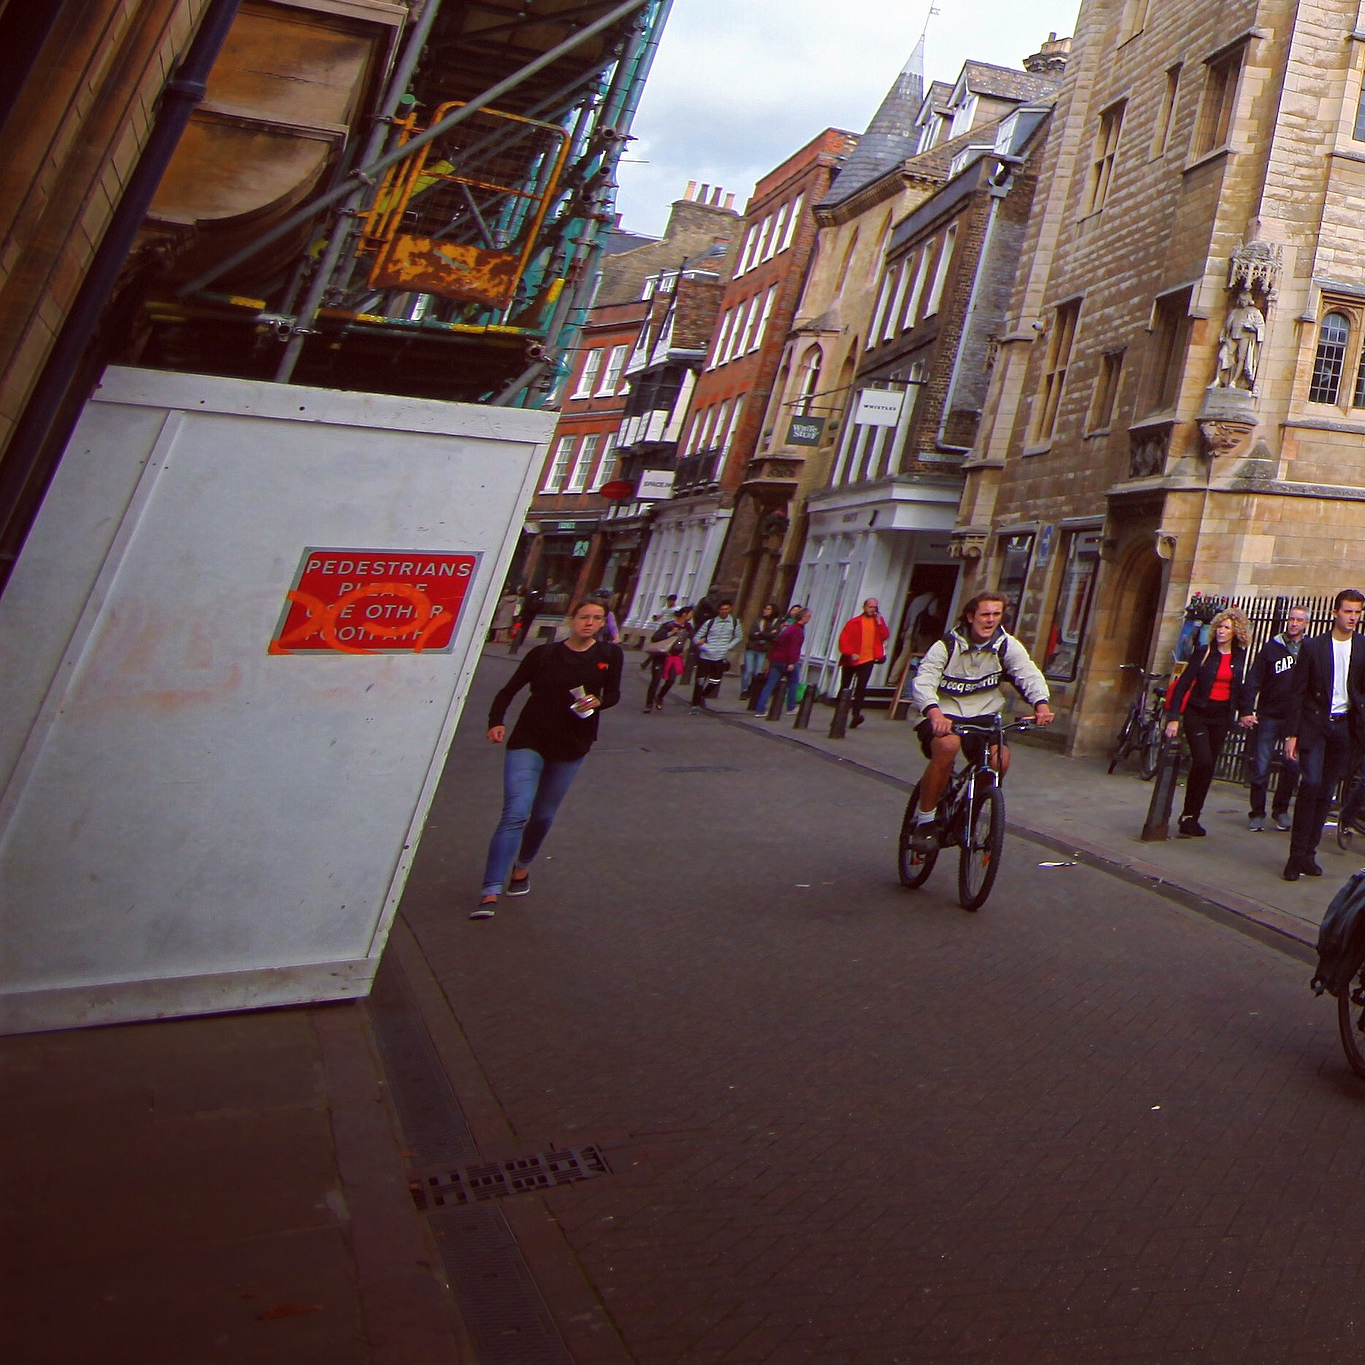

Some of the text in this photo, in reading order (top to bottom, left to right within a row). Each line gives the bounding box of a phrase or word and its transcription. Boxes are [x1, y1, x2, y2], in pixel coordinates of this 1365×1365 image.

[306, 560, 471, 577] PEDESTRIANS
[338, 583, 427, 597] PLEAE
[306, 605, 355, 618] UE
[365, 605, 443, 620] OTHR
[1275, 655, 1294, 674] GAP
[947, 681, 965, 693] coq
